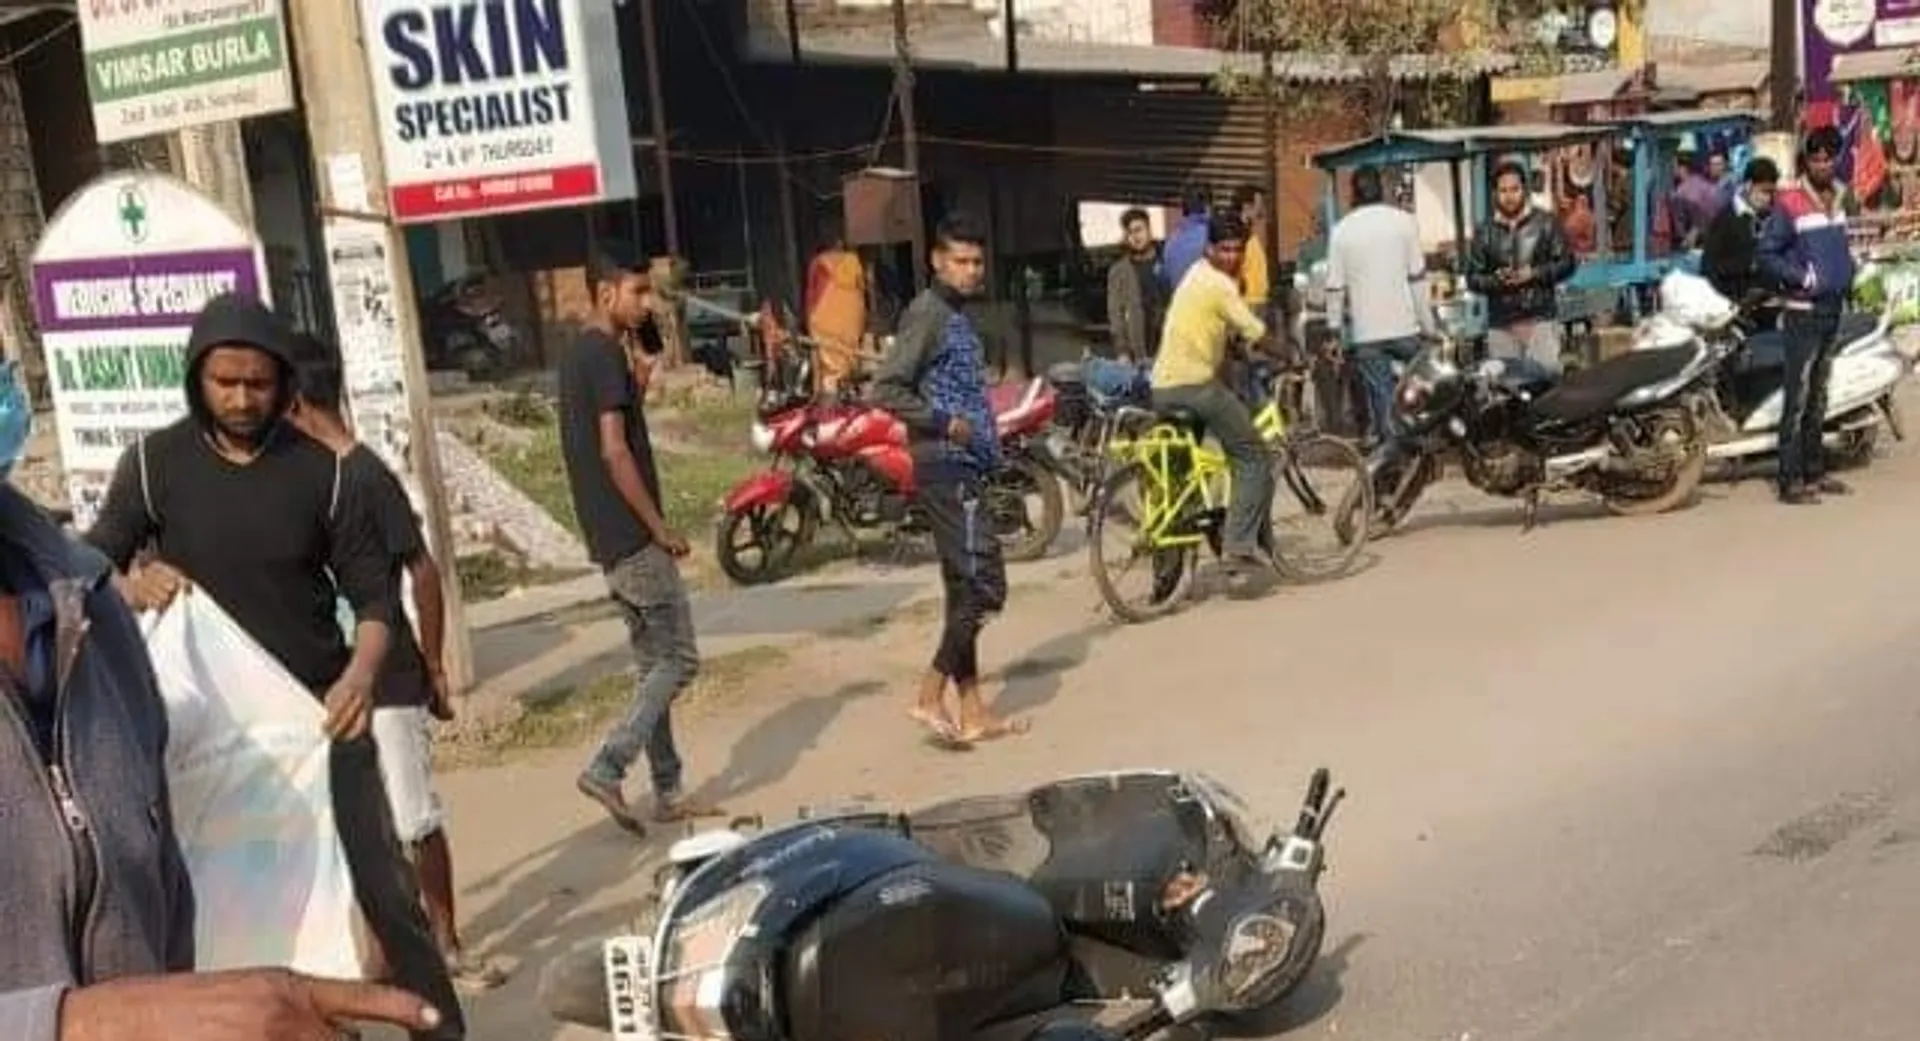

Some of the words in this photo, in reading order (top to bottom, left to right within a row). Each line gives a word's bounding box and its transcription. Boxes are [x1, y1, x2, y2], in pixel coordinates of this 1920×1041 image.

[95, 47, 187, 90] VIMSAR
[191, 29, 271, 72] BURLA
[383, 0, 568, 90] SKIN
[396, 83, 571, 142] SPECIALIST
